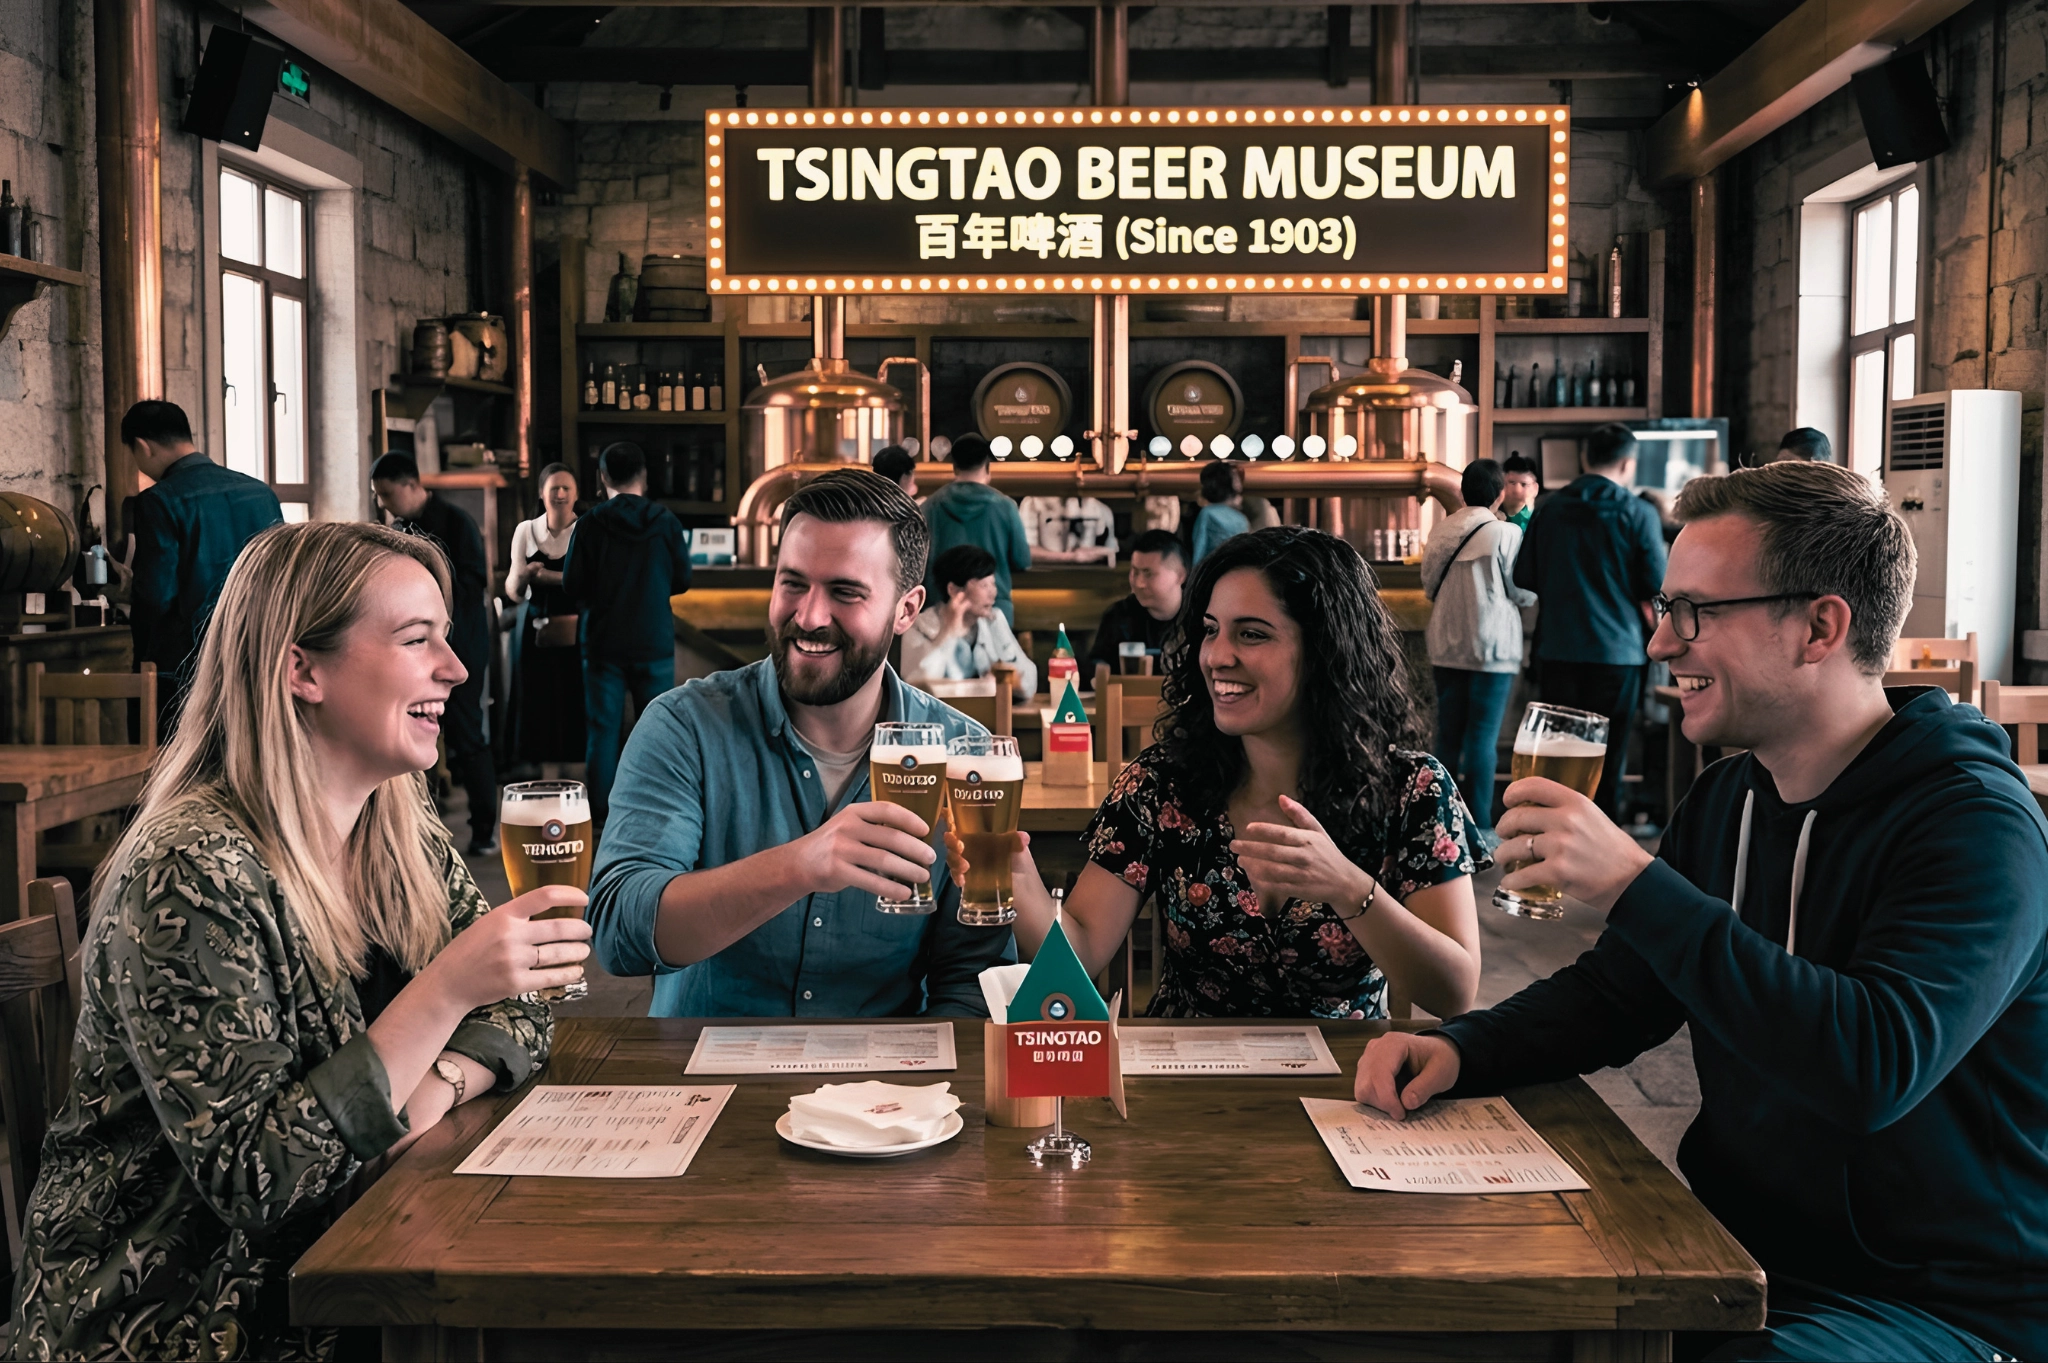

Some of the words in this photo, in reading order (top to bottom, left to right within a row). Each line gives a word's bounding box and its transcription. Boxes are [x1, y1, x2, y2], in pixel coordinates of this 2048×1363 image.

[756, 146, 1062, 202] TSINGTAO
[1077, 145, 1228, 200] BEER
[1242, 144, 1516, 200] MUSEUM
[915, 211, 1103, 260] 百年啤酒
[1115, 214, 1238, 261] (Since
[1248, 214, 1357, 261] 1903)
